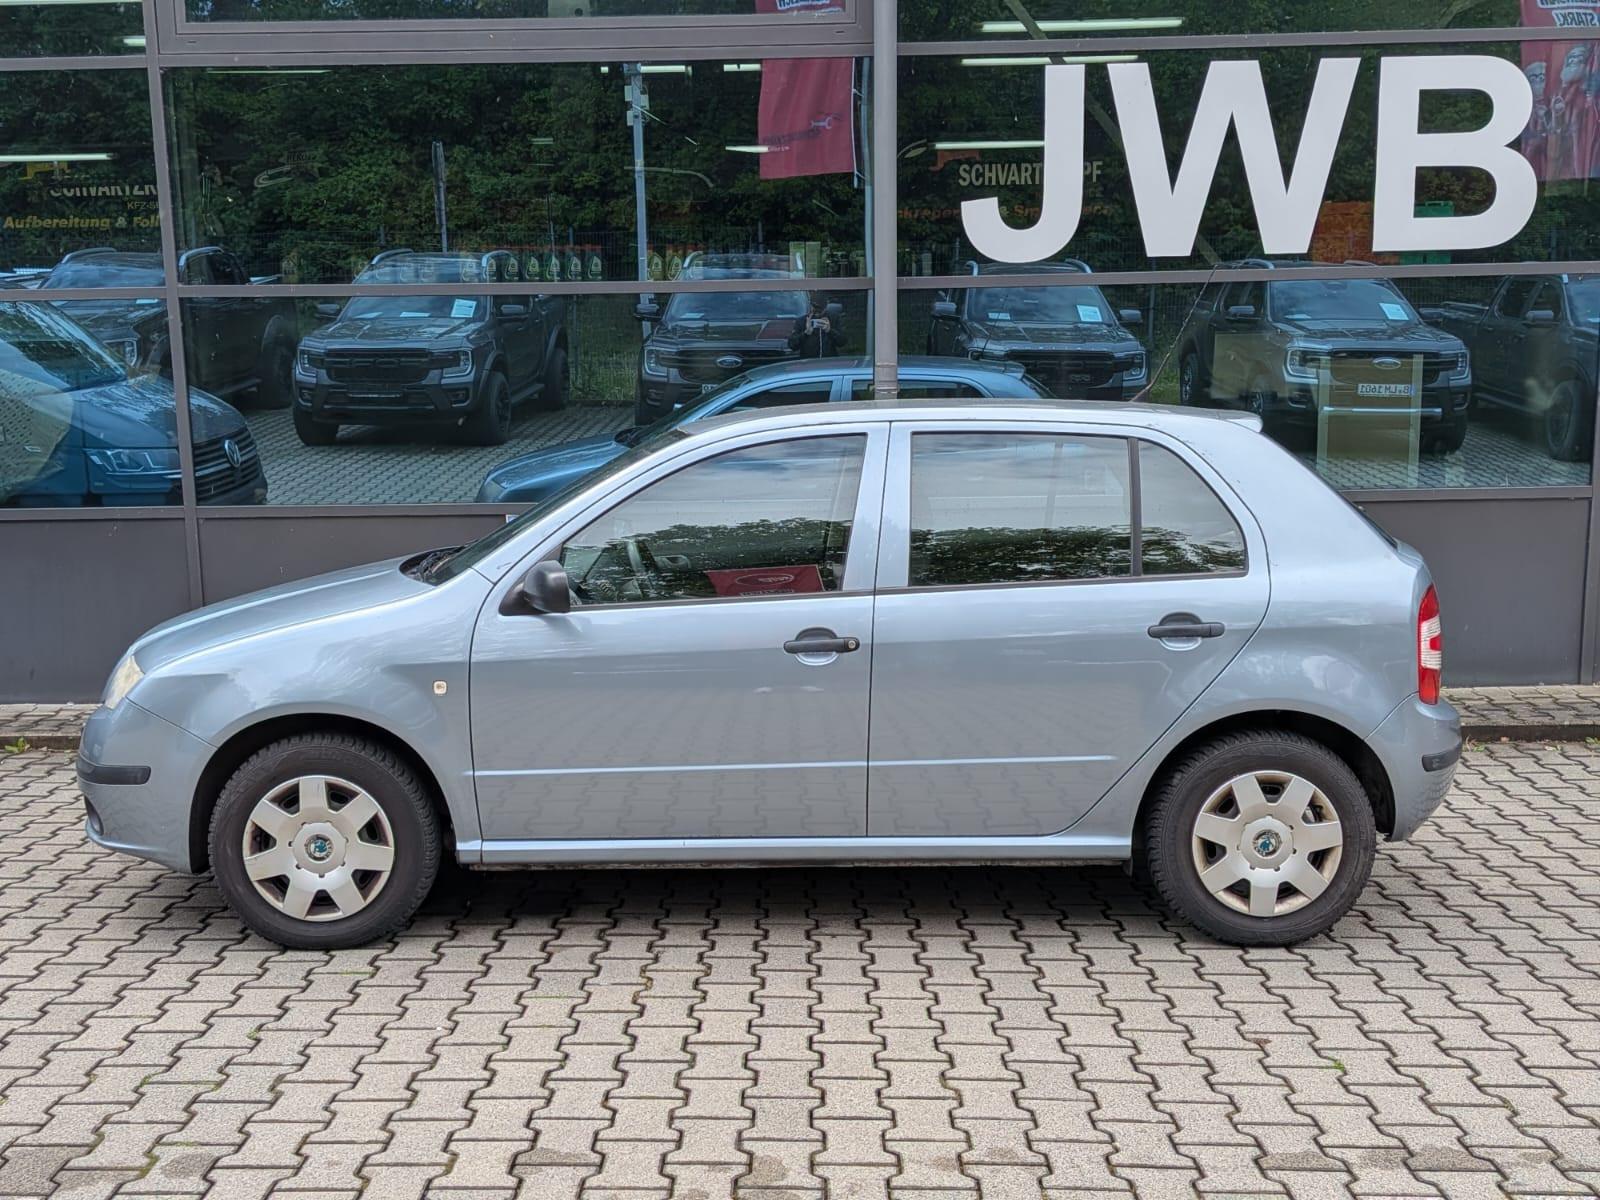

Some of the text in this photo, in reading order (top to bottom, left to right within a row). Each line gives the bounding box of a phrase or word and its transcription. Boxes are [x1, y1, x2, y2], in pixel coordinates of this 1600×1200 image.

[961, 55, 1537, 263] JWB
[958, 161, 1104, 187] SCHVARTPF
[3, 215, 111, 230] Aufbereitung
[115, 216, 128, 228] &
